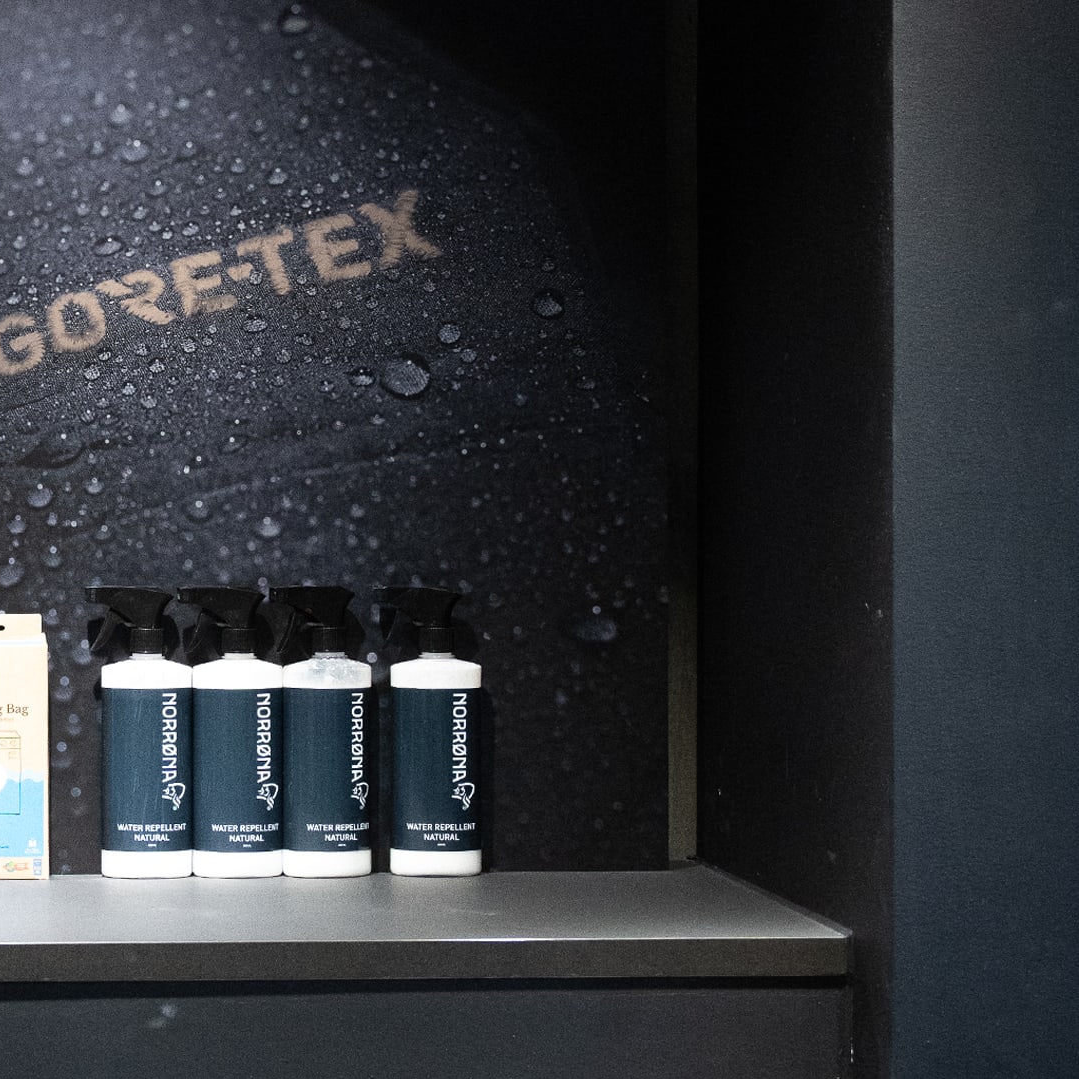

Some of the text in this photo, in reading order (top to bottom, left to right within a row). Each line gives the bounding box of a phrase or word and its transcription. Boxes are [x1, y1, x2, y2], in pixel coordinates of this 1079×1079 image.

[6, 703, 29, 716] Bag
[161, 693, 177, 783] NORRØNA
[256, 693, 271, 783] NORRØNA
[351, 693, 364, 782] NORRØNA
[452, 693, 467, 783] NORRØNA
[117, 823, 187, 832] WATER REPELLENT
[211, 823, 279, 832] WATER REPELLENT
[306, 823, 334, 832] WATER
[406, 822, 476, 831] WATER REPELLENT
[133, 834, 170, 842] NATURAL
[229, 834, 264, 842] NATURAL
[324, 833, 358, 842] NATURAL
[423, 833, 460, 841] NATURAL
